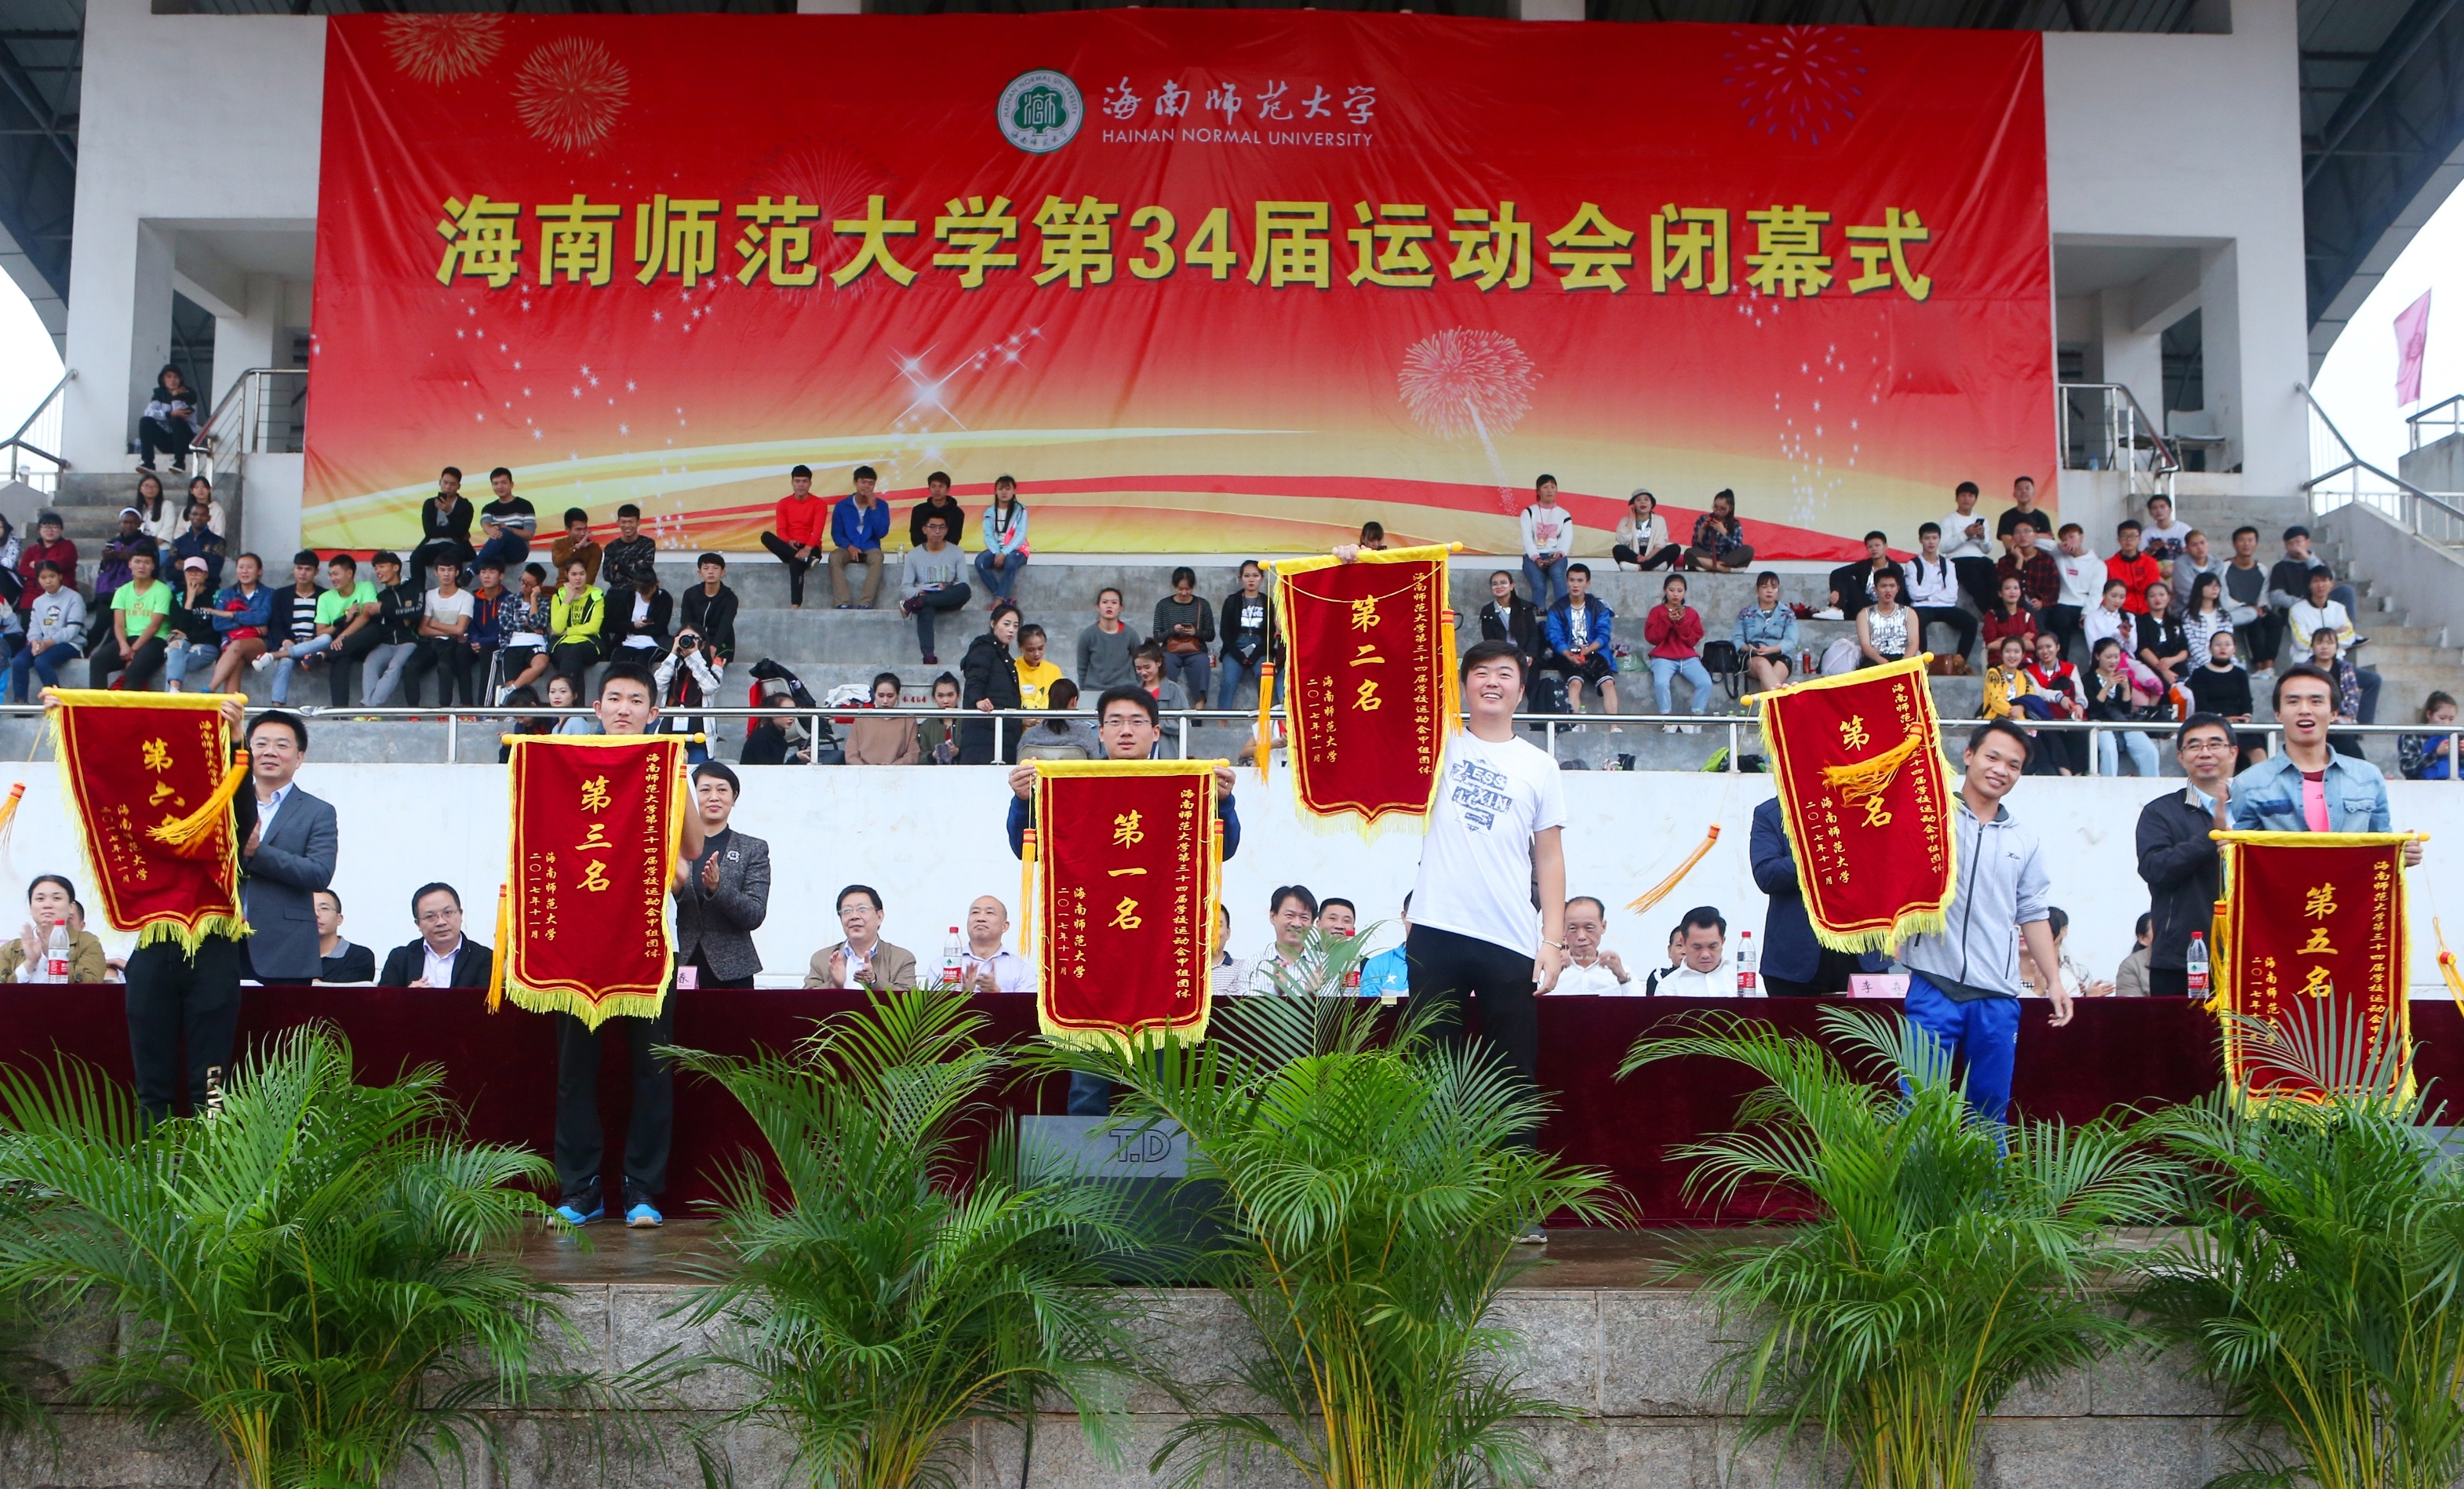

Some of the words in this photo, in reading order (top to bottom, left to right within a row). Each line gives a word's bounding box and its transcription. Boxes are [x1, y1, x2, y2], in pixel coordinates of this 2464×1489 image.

[1103, 76, 1376, 125] 海南师范大学
[1103, 129, 1174, 142] HAINAN
[1181, 130, 1261, 145] NORMAL
[1268, 132, 1373, 147] UNIVERSITY
[435, 192, 1931, 302] 海南师范大学第34届运动会闭幕式
[1349, 595, 1385, 712] 第二名
[1323, 675, 1338, 763] 海南师范大学
[1839, 714, 1893, 828] 第名
[575, 775, 613, 892] 第三名
[1107, 810, 1148, 930] 第一名
[1821, 796, 1850, 884] 海南师范大学
[545, 851, 558, 941] 海南师范大学
[1072, 886, 1087, 979] 海南师范大学
[2296, 883, 2338, 999] 第五名
